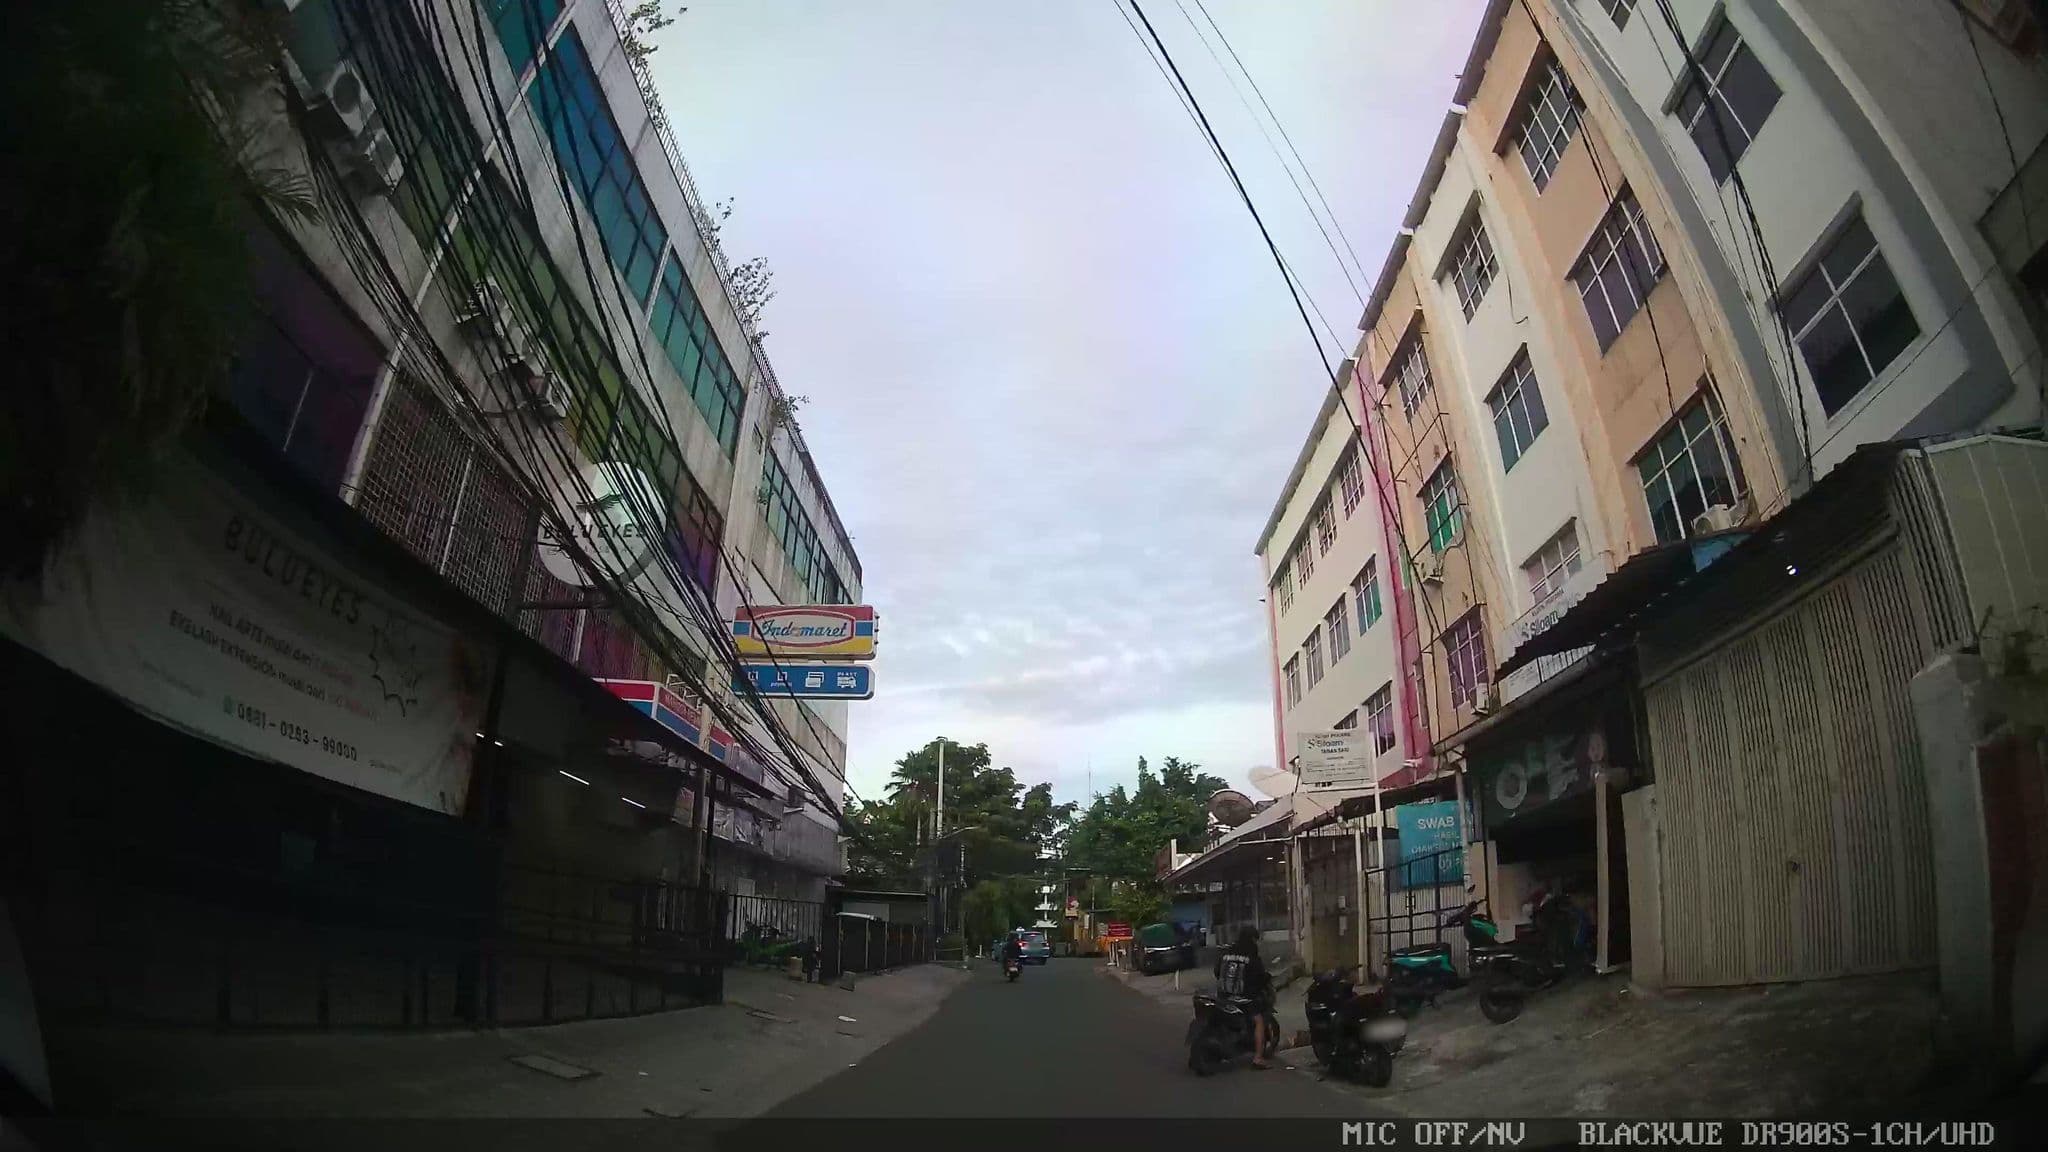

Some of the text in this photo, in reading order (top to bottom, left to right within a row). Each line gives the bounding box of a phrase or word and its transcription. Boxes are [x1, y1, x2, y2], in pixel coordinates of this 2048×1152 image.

[542, 523, 647, 539] BLUEYES
[224, 514, 361, 625] BULUEYES
[761, 619, 847, 637] Indomaret
[1417, 816, 1455, 830] SWAB
